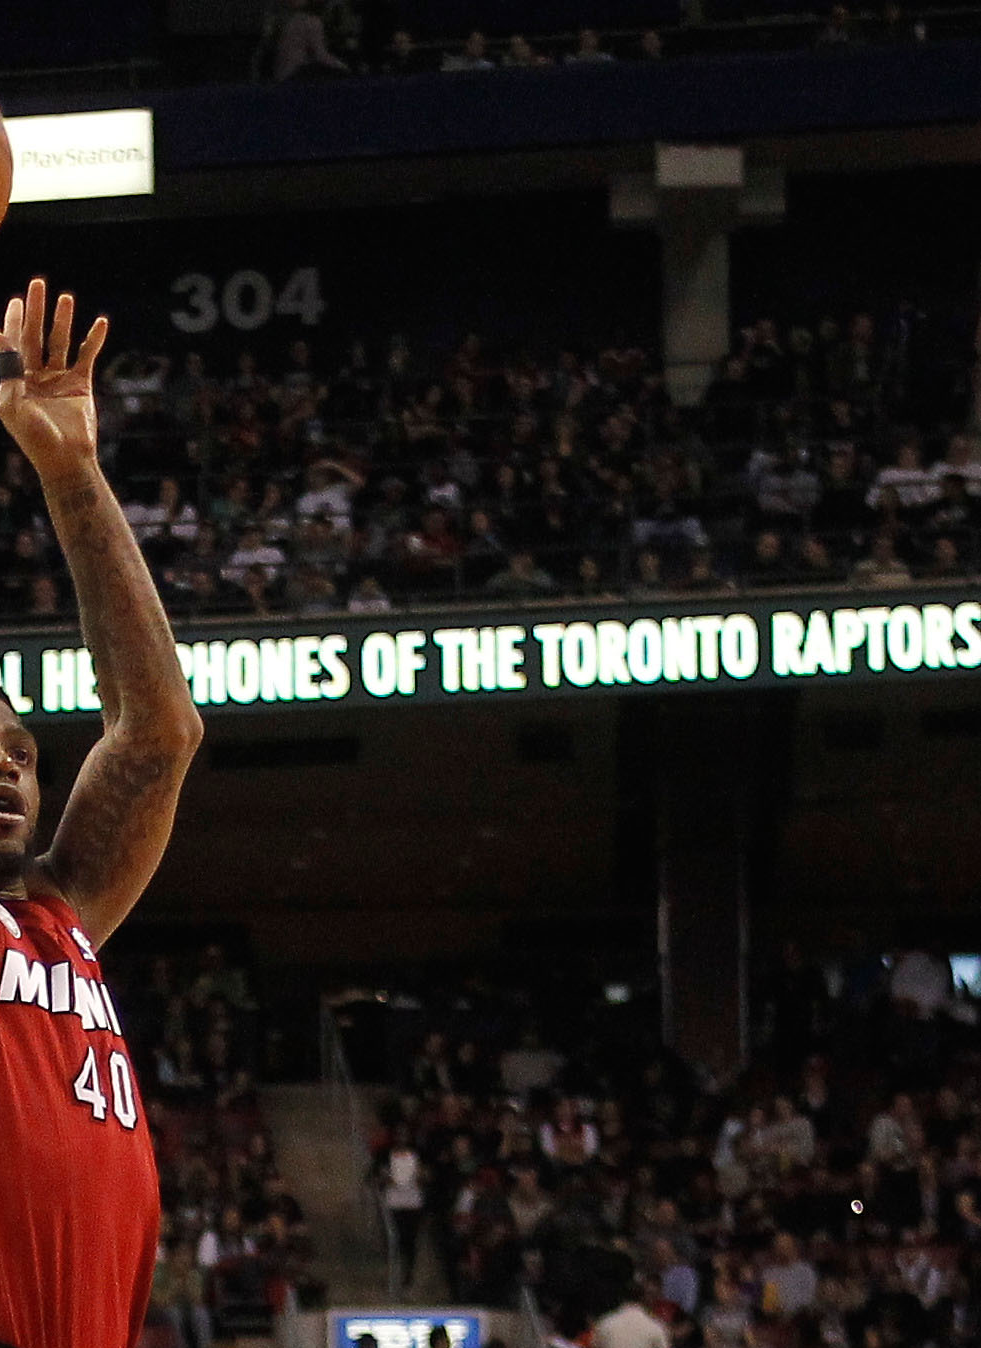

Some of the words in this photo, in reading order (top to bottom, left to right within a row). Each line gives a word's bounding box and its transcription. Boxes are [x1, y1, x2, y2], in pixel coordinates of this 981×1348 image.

[170, 267, 327, 333] 304
[42, 633, 351, 712] HEHONES
[361, 630, 426, 697] OF
[433, 625, 527, 693] THE
[533, 613, 760, 688] TORONTO
[771, 602, 981, 676] RAPTORS
[73, 1046, 137, 1129] 40
